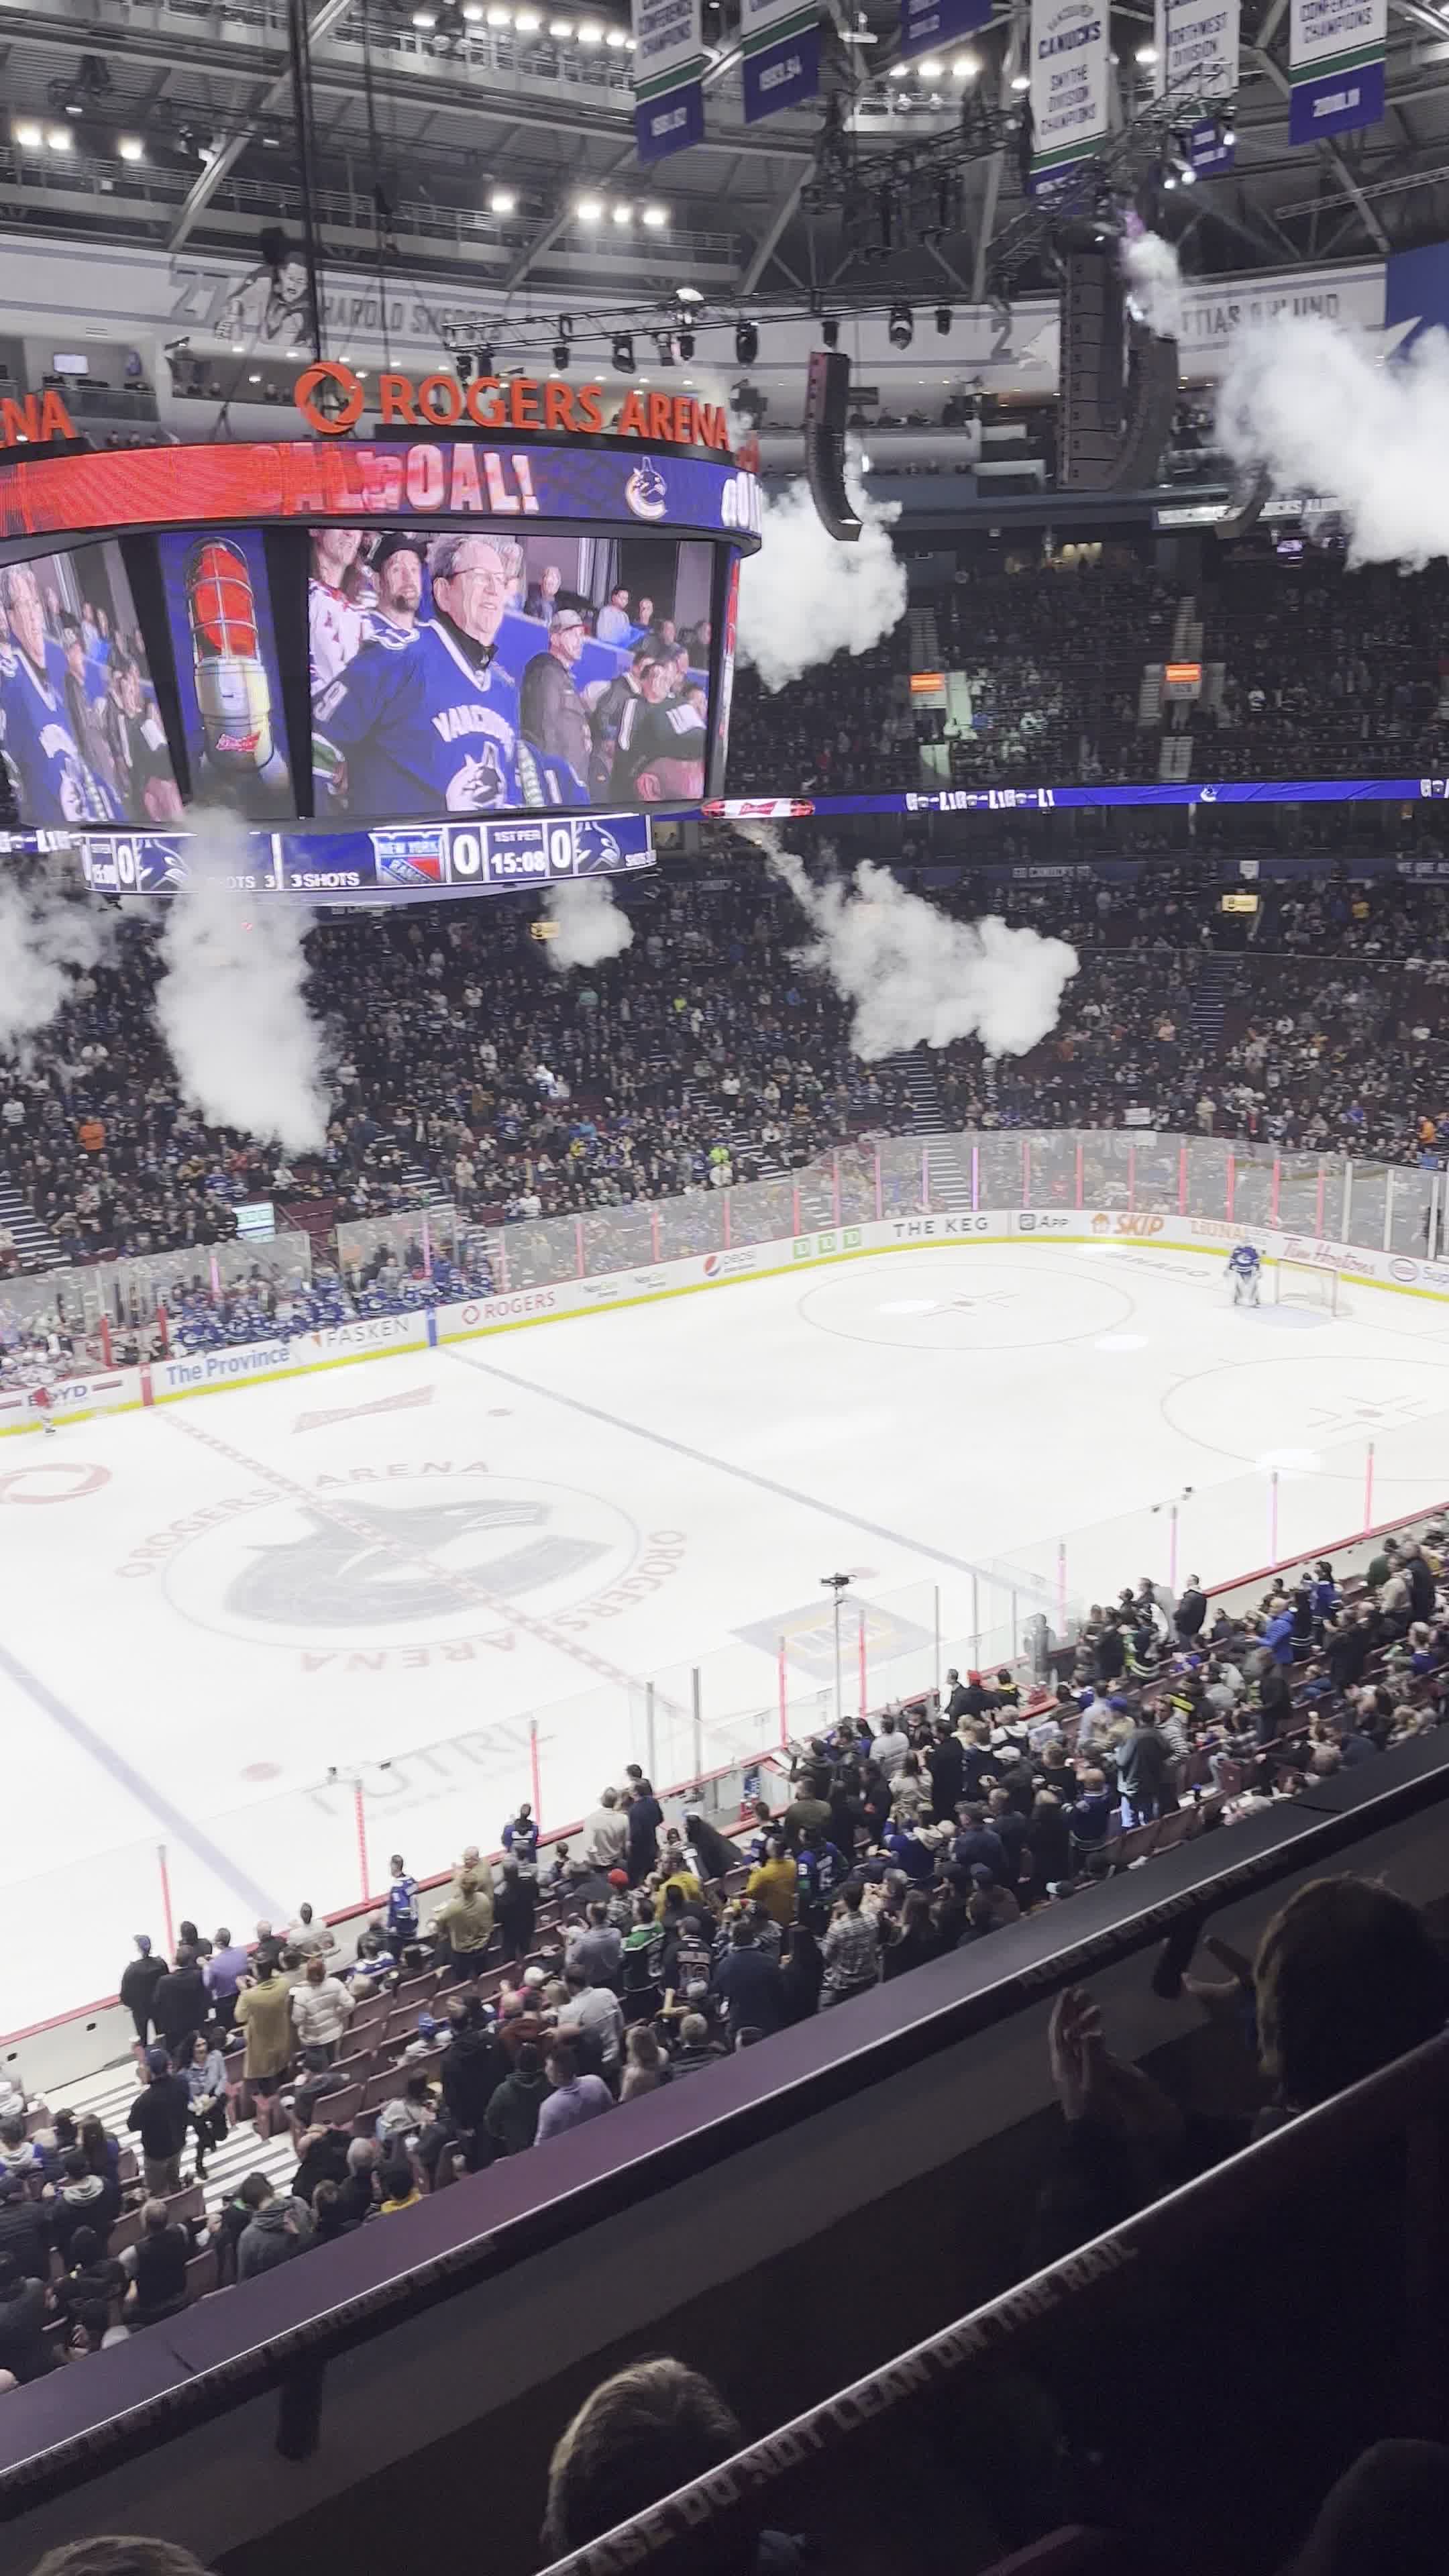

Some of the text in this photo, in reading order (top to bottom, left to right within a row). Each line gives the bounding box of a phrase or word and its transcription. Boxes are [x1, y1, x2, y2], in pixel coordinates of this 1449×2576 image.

[1181, 305, 1240, 335] TTIAS
[380, 374, 731, 451] ROGERS ARENA
[452, 833, 480, 875] 0
[490, 851, 546, 874] 15:08
[550, 829, 573, 869] 0
[290, 872, 360, 888] 3 SHOTS
[893, 1217, 989, 1238] THE KEG
[1114, 1214, 1164, 1236] SKIP
[484, 1291, 556, 1320] ROGERS
[327, 1318, 409, 1347] FASKEN
[166, 1346, 291, 1386] The Province
[28, 1385, 88, 1407] BYD
[140, 1460, 490, 1563] ROGERS ARENA
[672, 2471, 741, 2526] DO
[830, 2357, 933, 2432] LEAN
